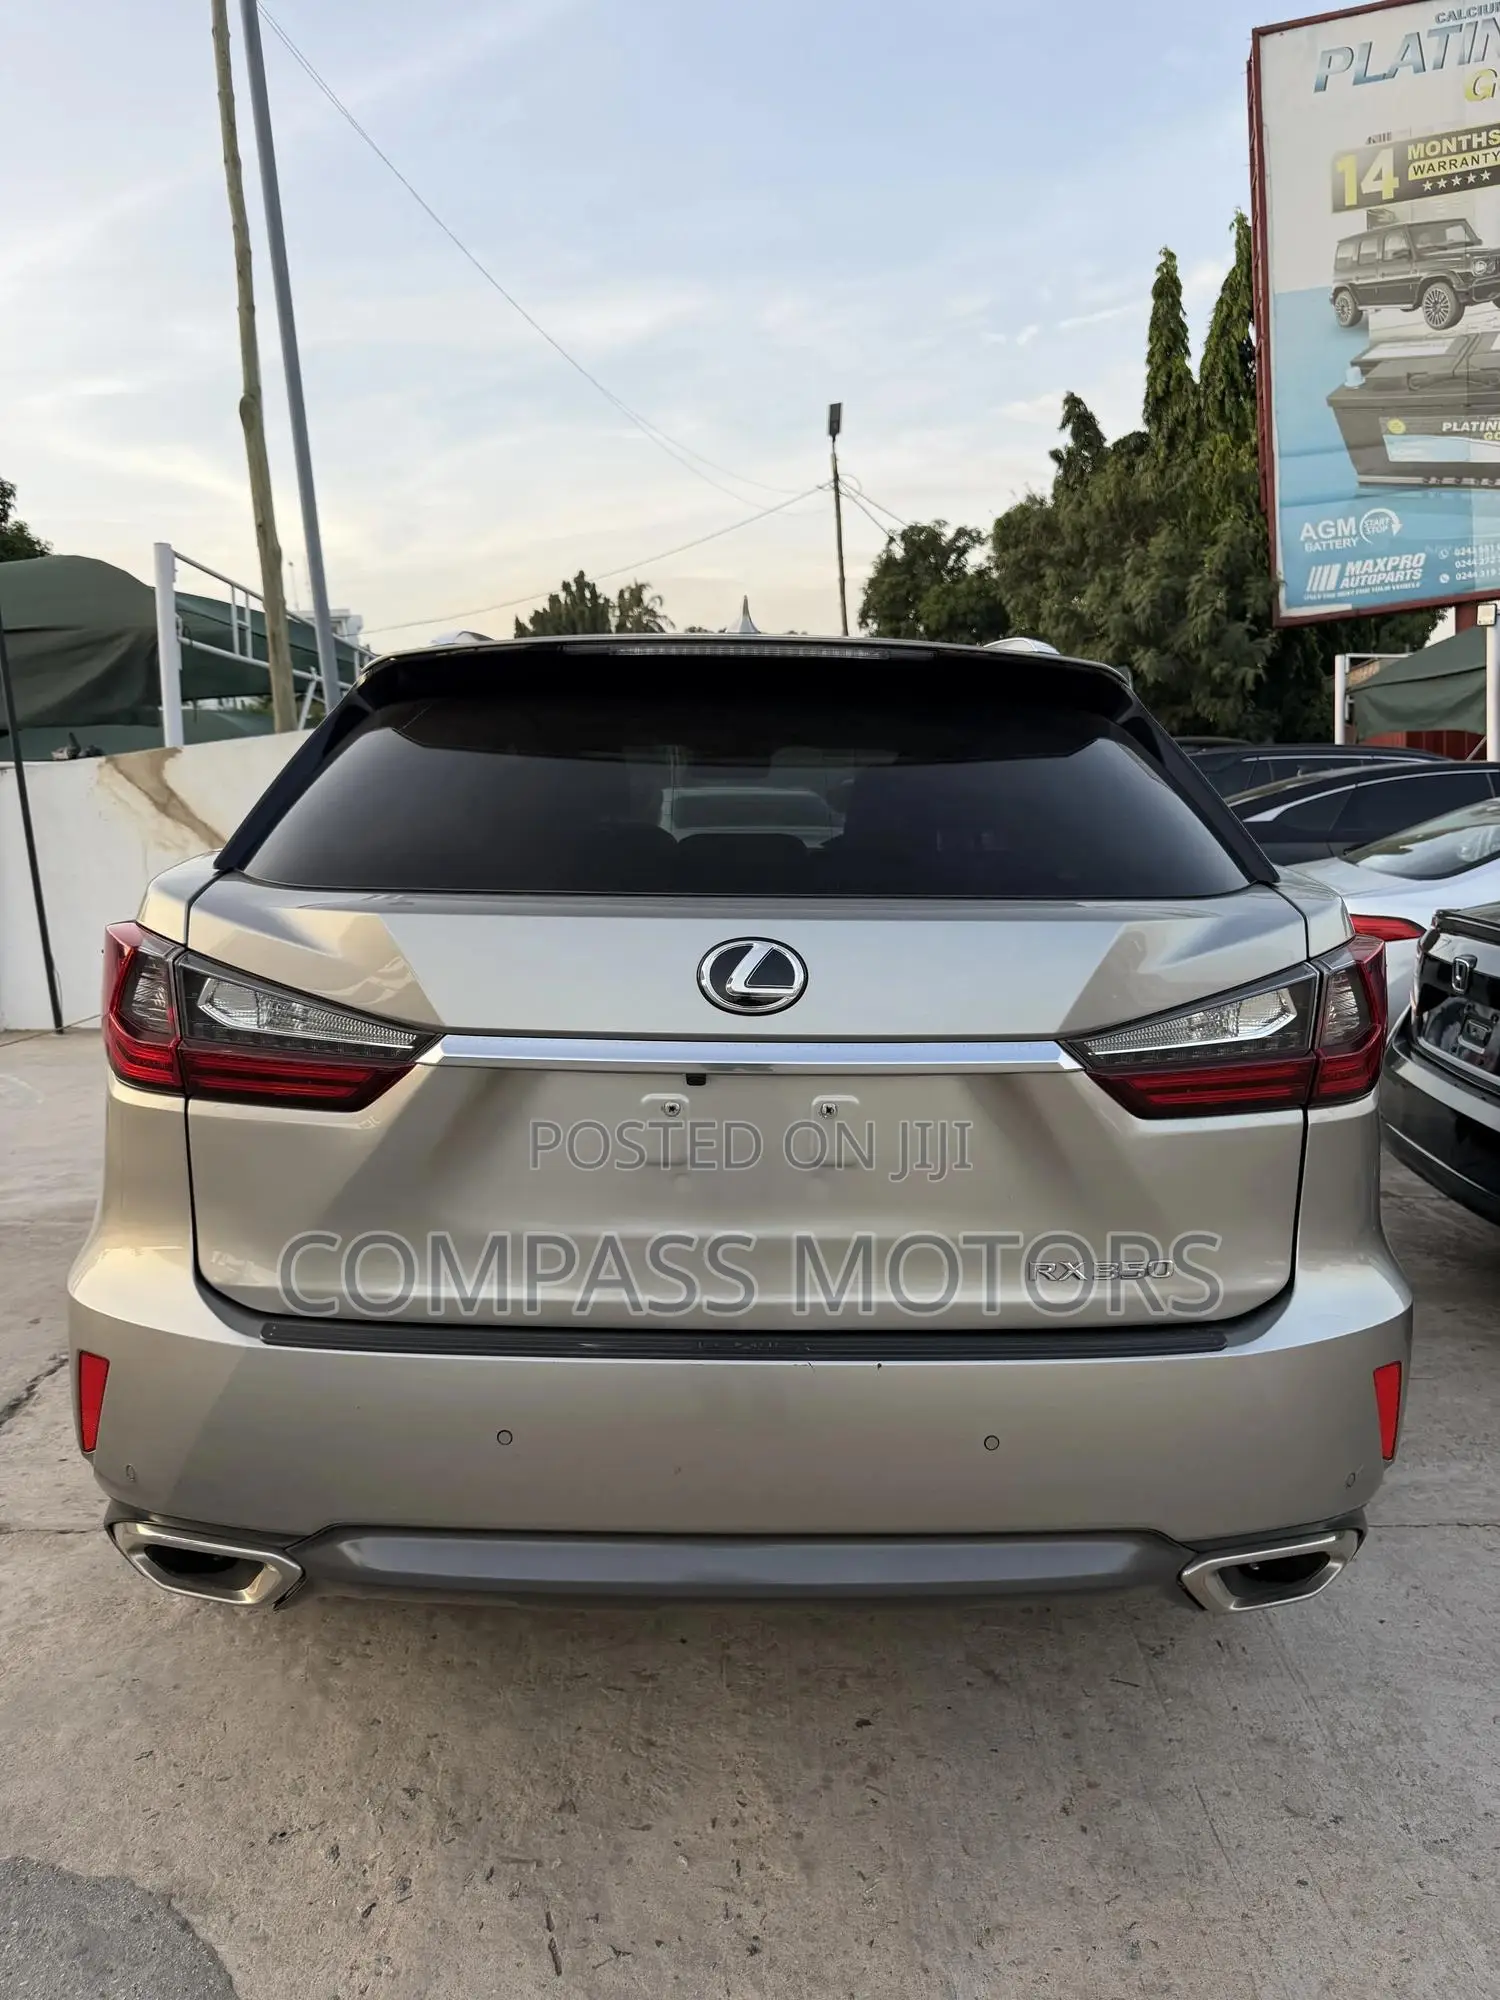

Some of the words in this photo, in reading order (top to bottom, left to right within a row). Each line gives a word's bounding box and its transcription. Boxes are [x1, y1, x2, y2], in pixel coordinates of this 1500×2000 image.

[1408, 129, 1500, 160] MONTHS
[1413, 151, 1500, 176] WARRANTY
[1336, 147, 1399, 206] 14
[1300, 516, 1357, 541] AGM
[1304, 536, 1359, 552] BATTERY
[1345, 553, 1426, 576] MAXPRO
[1340, 568, 1422, 589] AUTOPARTS
[1029, 1261, 1087, 1281] RX
[1094, 1259, 1174, 1280] 350
